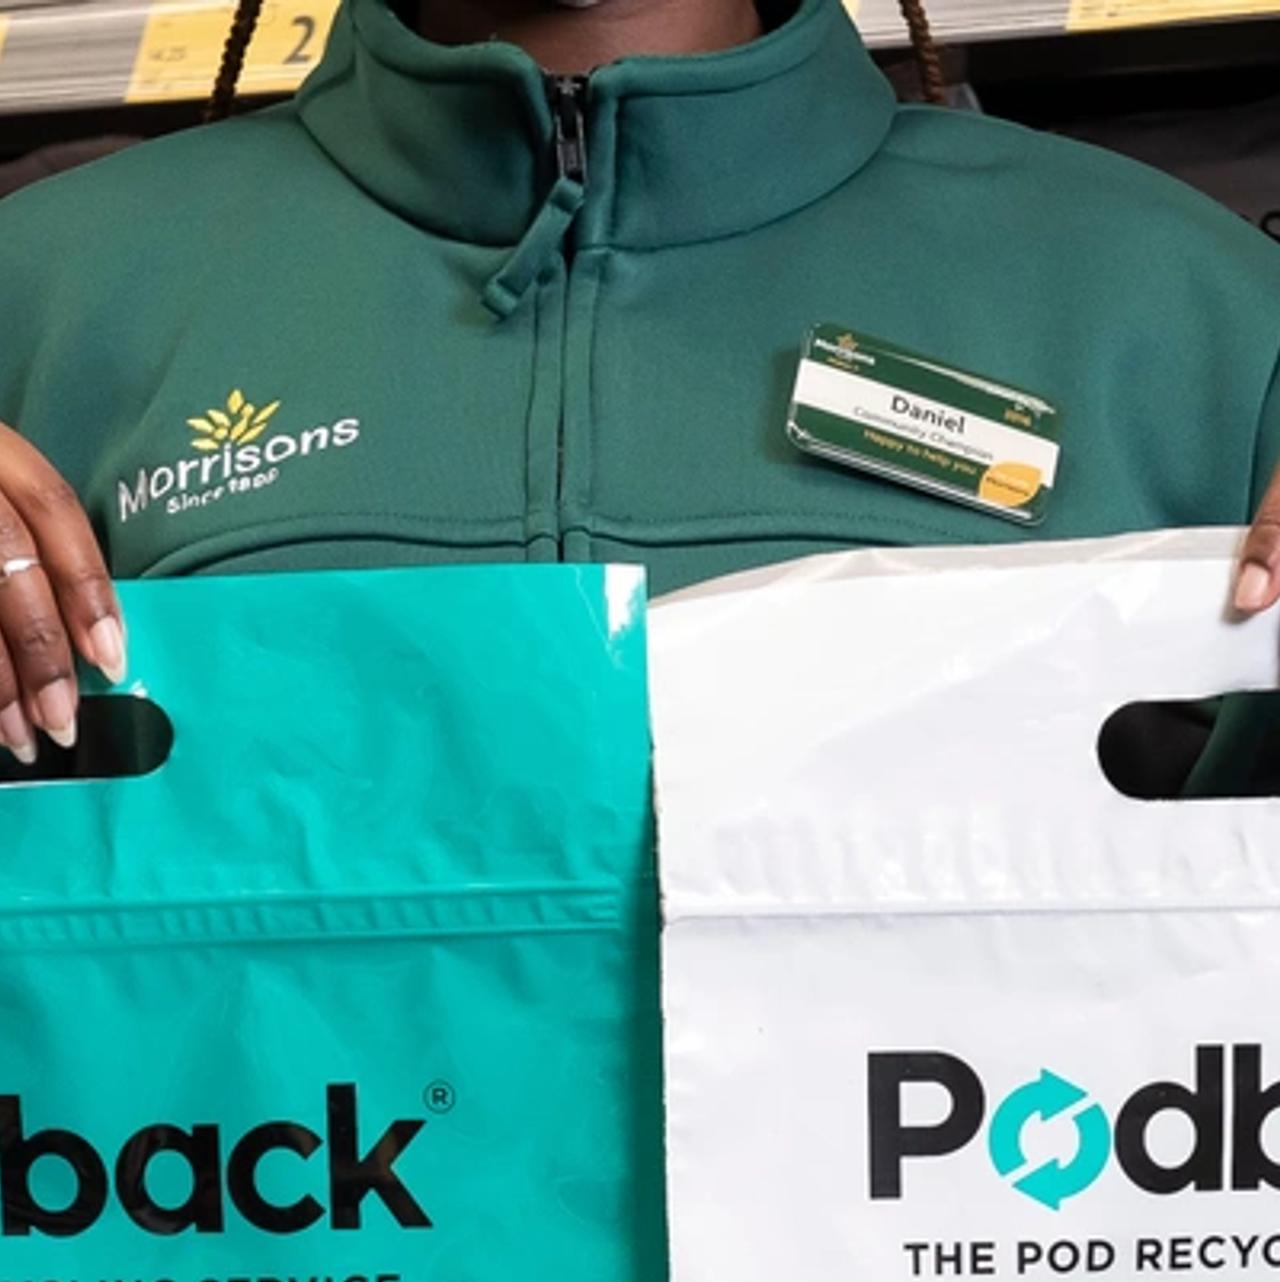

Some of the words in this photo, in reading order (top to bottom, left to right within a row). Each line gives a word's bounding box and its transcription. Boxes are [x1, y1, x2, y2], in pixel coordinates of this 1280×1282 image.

[282, 15, 316, 64] 2
[891, 395, 965, 434] Daniel
[119, 418, 359, 522] Morrisons
[904, 1241, 994, 1276] THE
[1017, 1239, 1115, 1274] POD
